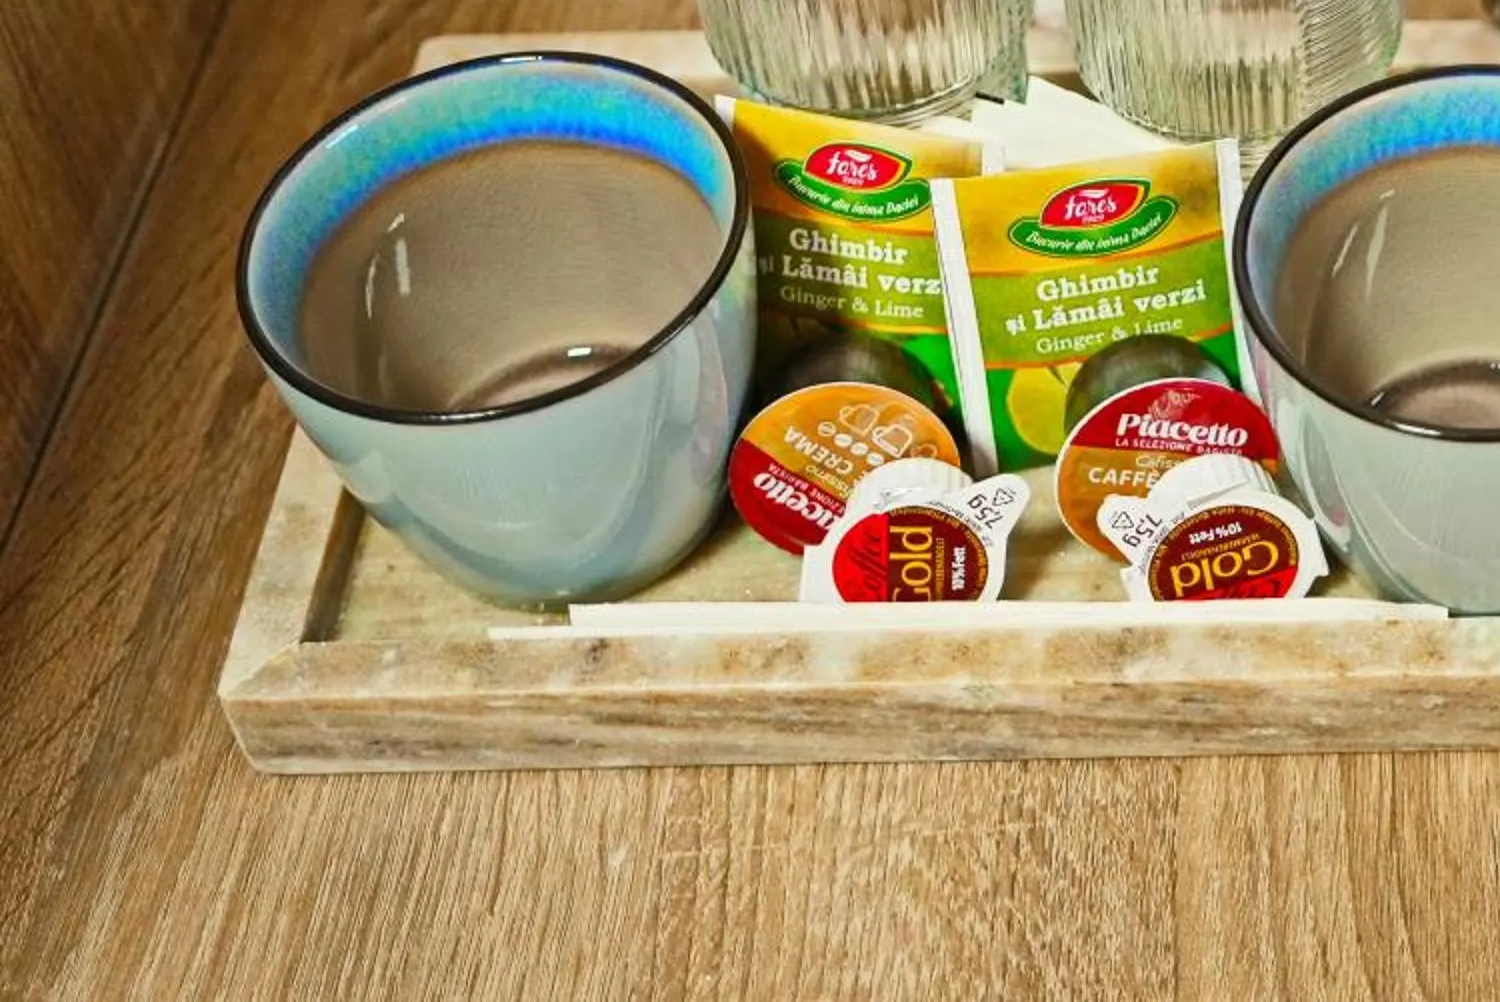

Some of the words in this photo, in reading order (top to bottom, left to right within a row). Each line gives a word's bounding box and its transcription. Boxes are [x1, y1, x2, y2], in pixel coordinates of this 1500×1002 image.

[789, 228, 908, 265] Ghimbir
[782, 255, 869, 289] Lămâi
[878, 276, 944, 296] verz
[1036, 265, 1160, 303] Ghimbir
[780, 286, 846, 311] Ginger
[852, 295, 869, 314] &
[875, 300, 924, 319] Lime
[1032, 298, 1126, 332] Lămâi
[1133, 278, 1207, 313] verzi
[1036, 330, 1105, 355] Ginger
[1112, 324, 1129, 340] &
[1134, 317, 1184, 337] Lime
[1115, 438, 1129, 448] LA
[1132, 439, 1194, 453] SELEZIONE
[1116, 413, 1249, 447] Piacetto
[784, 425, 854, 475] CREMA
[753, 472, 837, 531] acetto
[1189, 528, 1215, 545] Fett
[1215, 521, 1243, 539] 10%
[1170, 540, 1279, 598] Gold
